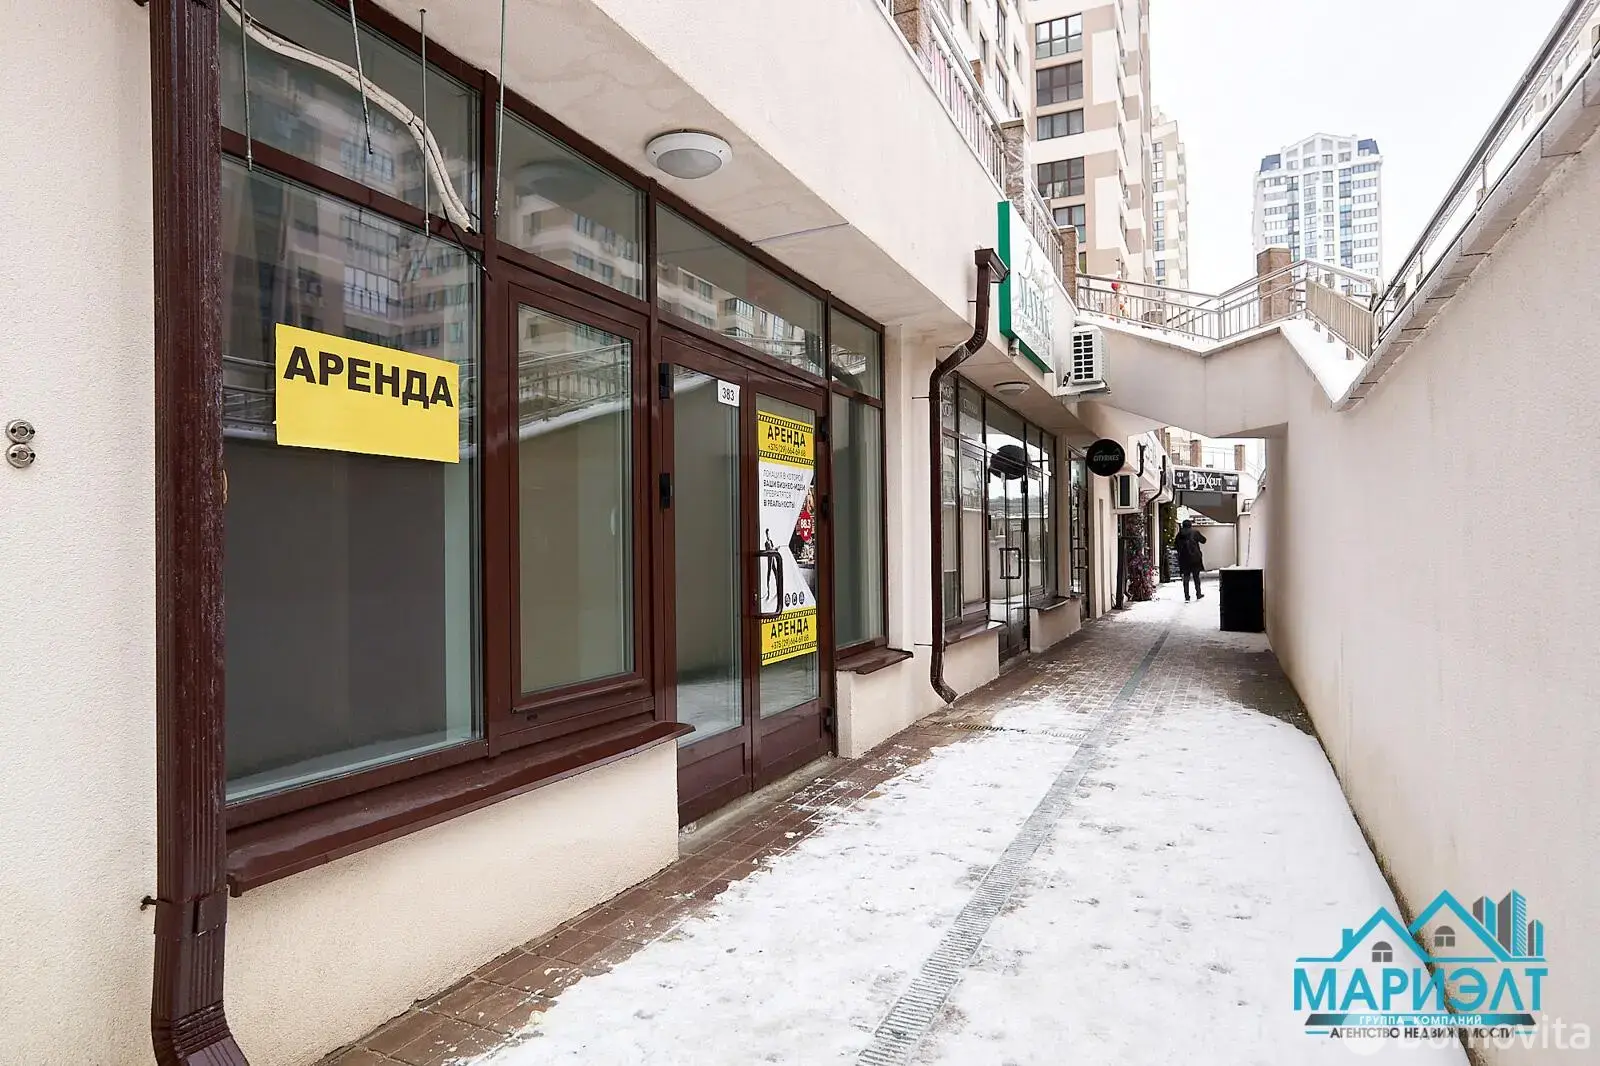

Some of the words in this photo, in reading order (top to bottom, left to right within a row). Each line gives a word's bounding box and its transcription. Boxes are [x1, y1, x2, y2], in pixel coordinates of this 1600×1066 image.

[283, 346, 454, 409] АРЕНДА
[722, 387, 735, 401] 383
[767, 425, 806, 448] АРЕНДА
[763, 479, 777, 488] ВАШИ
[771, 618, 809, 639] АРЕНДА
